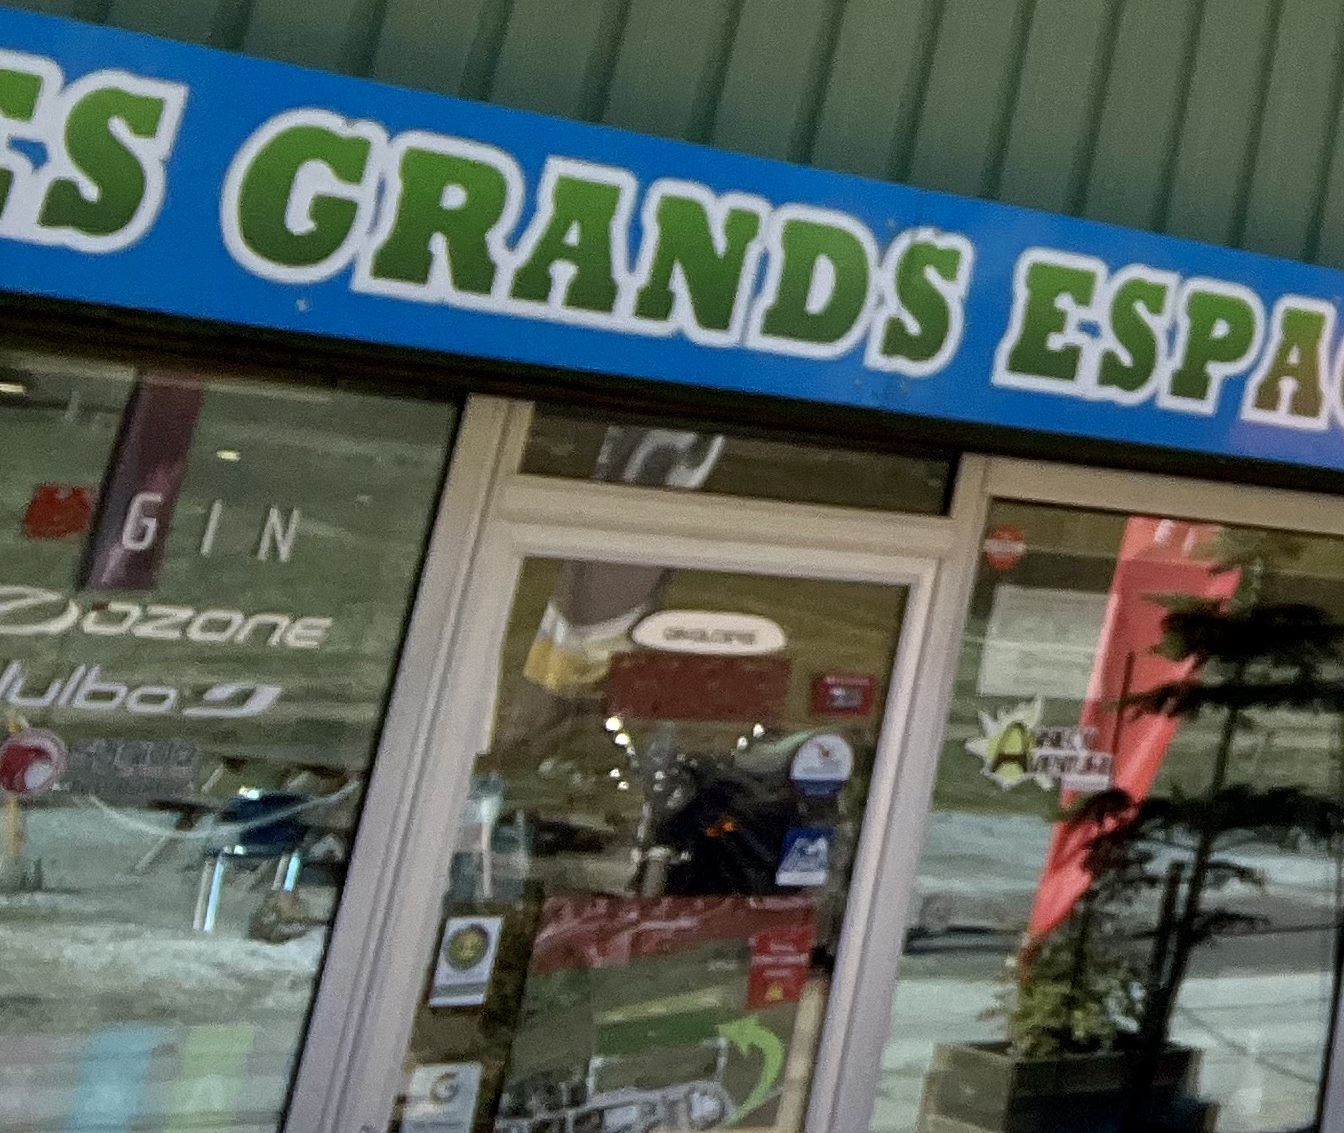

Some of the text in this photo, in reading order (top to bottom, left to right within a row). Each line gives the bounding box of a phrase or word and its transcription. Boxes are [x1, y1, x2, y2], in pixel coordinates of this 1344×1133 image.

[0, 58, 182, 248] S
[228, 112, 968, 373] GRANDS
[122, 492, 302, 563] GIN
